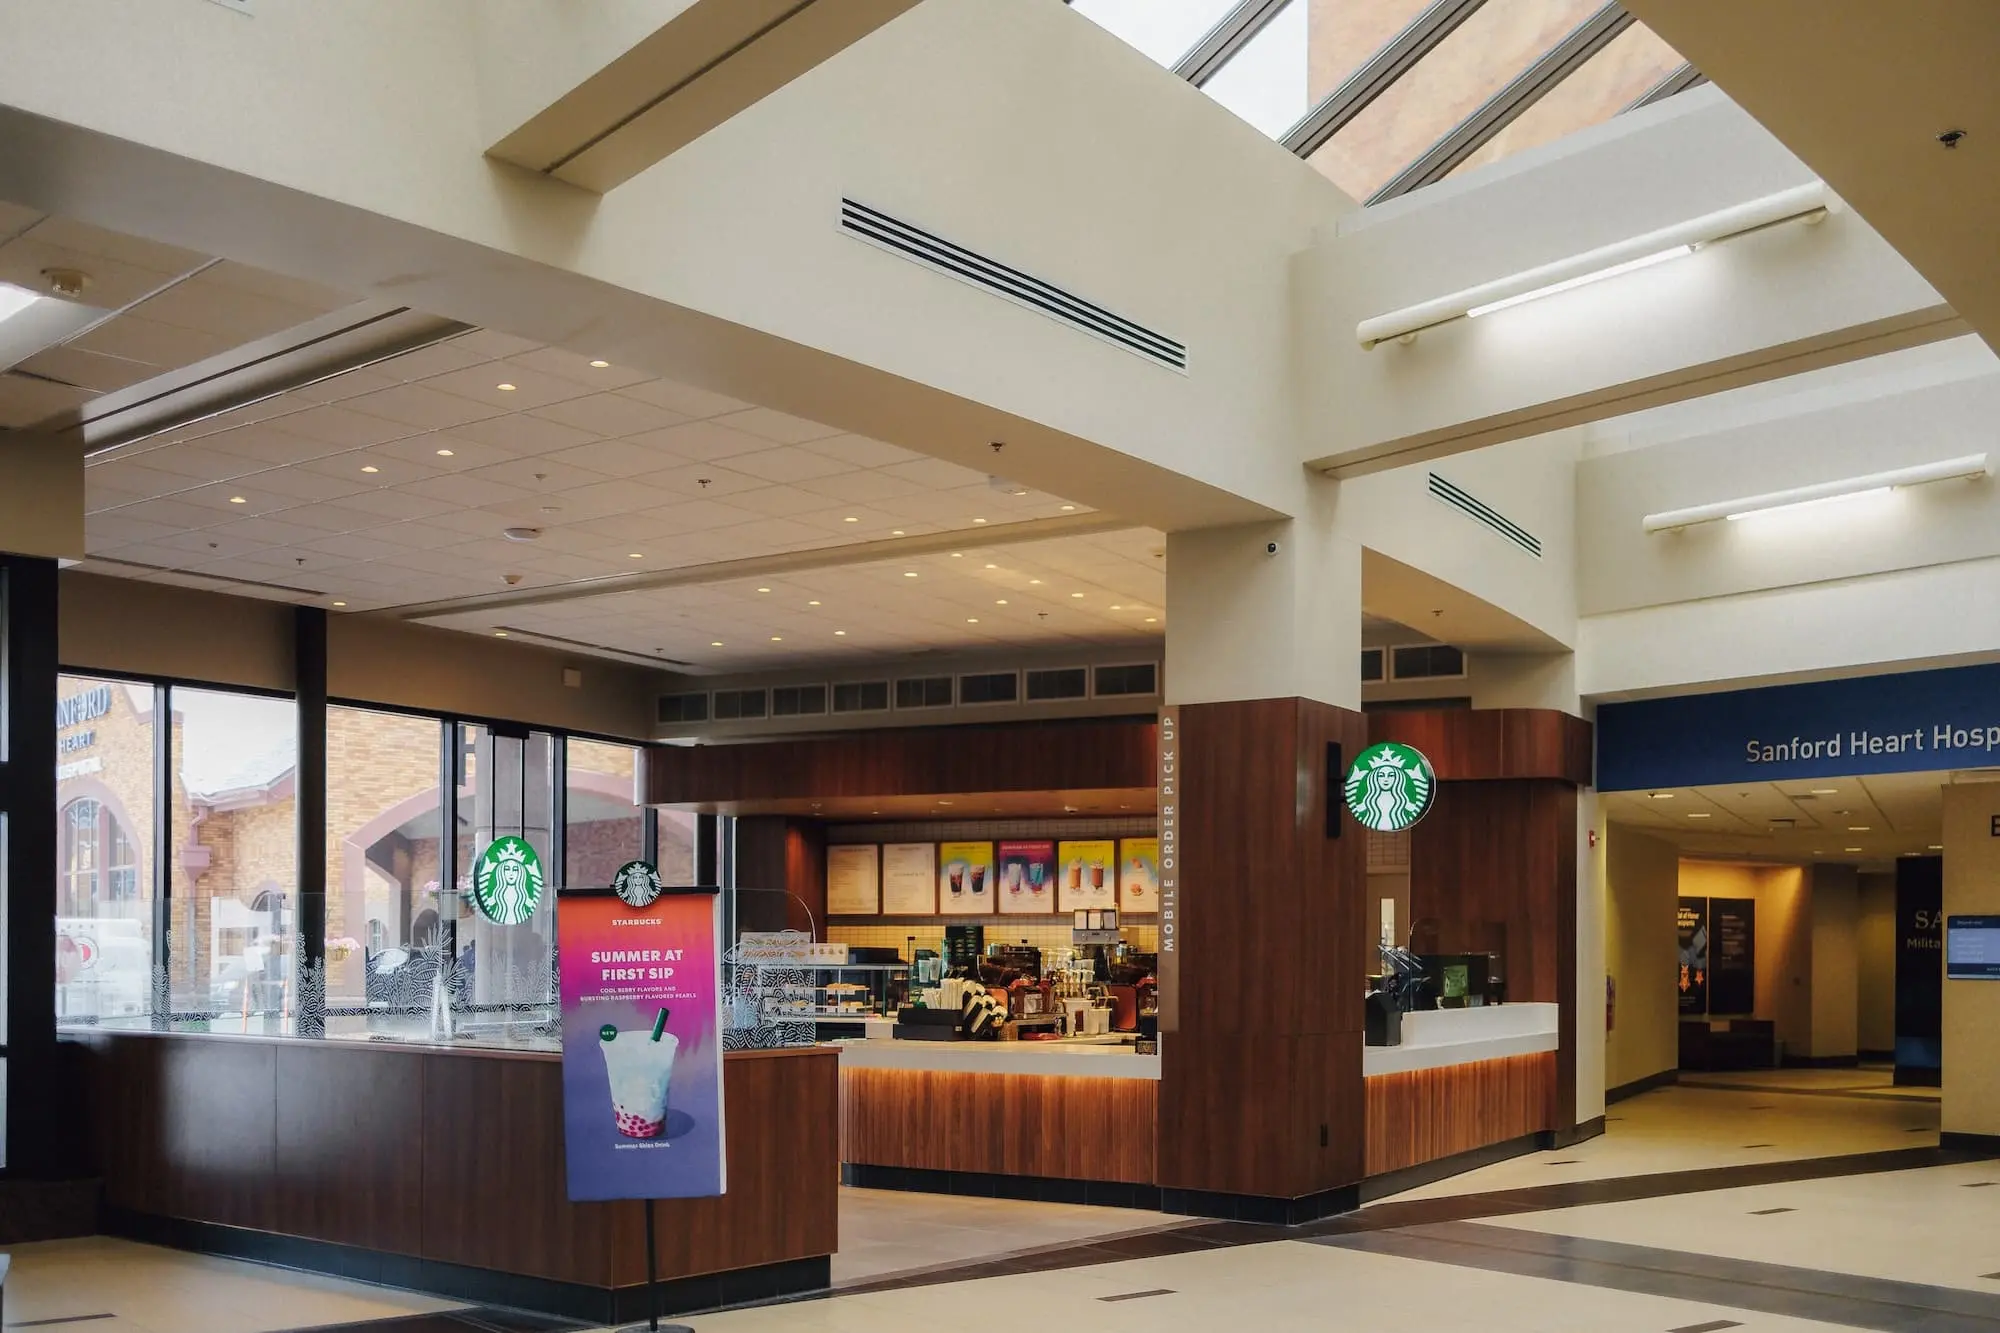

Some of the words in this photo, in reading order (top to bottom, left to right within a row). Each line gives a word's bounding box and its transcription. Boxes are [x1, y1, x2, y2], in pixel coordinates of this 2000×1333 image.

[1163, 716, 1174, 740] UP
[1746, 732, 1841, 763] Sanford
[1850, 728, 1924, 756] Heart
[1163, 751, 1174, 795] PICK
[1163, 805, 1174, 869] ORDER
[612, 918, 662, 926] STARBUCKS
[1163, 879, 1174, 952] MOBILE
[591, 950, 661, 963] SUMMER
[664, 949, 684, 961] AT
[602, 968, 646, 981] FIRST
[648, 967, 674, 979] SIP
